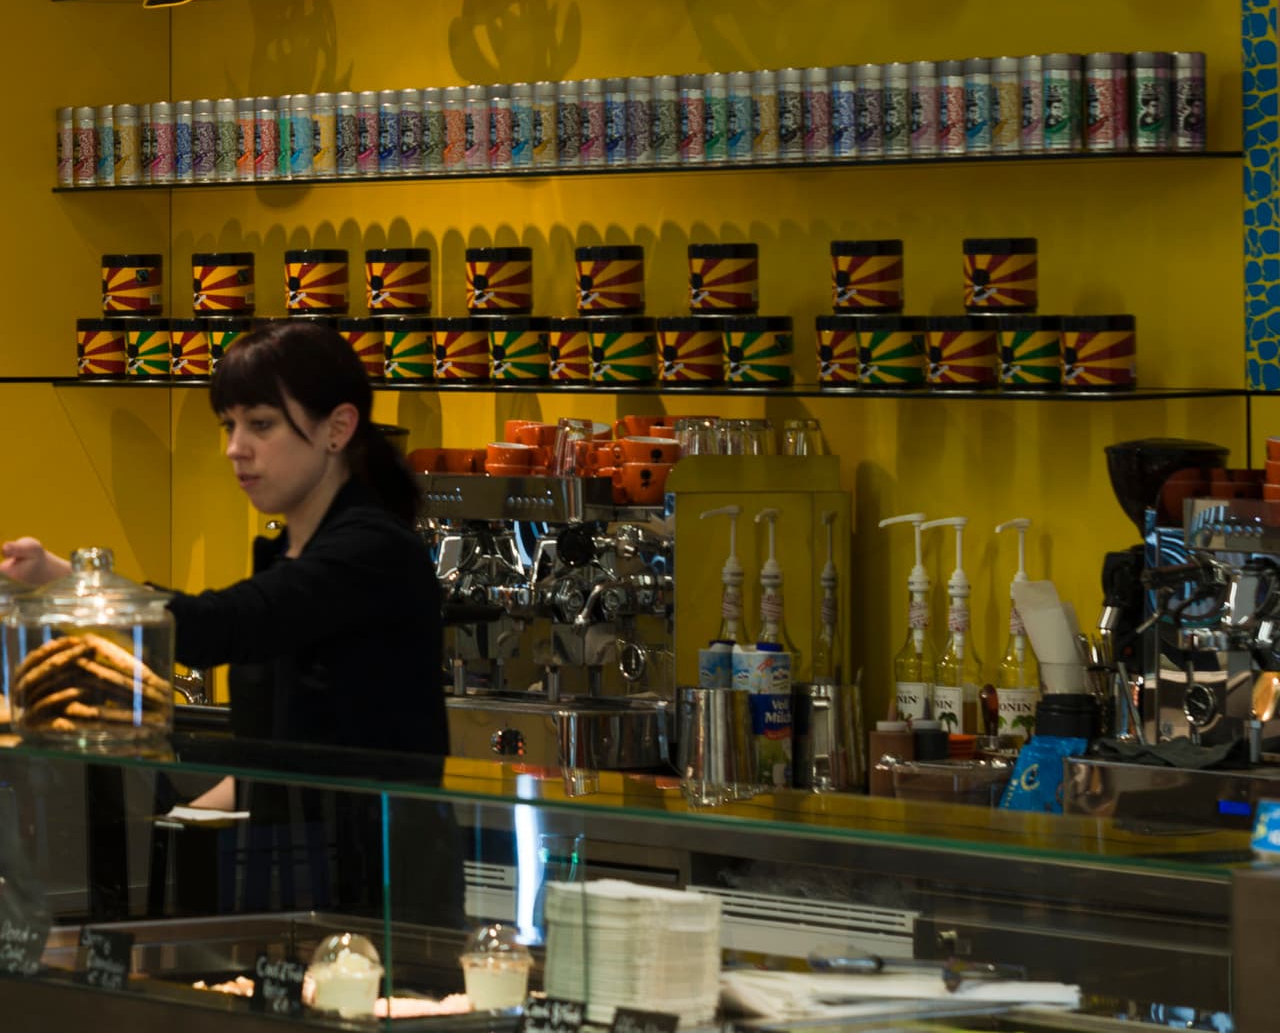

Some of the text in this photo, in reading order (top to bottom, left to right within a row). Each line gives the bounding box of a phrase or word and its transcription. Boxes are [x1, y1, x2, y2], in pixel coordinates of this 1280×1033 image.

[896, 694, 918, 705] NIN
[998, 702, 1033, 712] ONIN
[764, 711, 792, 724] Milc
